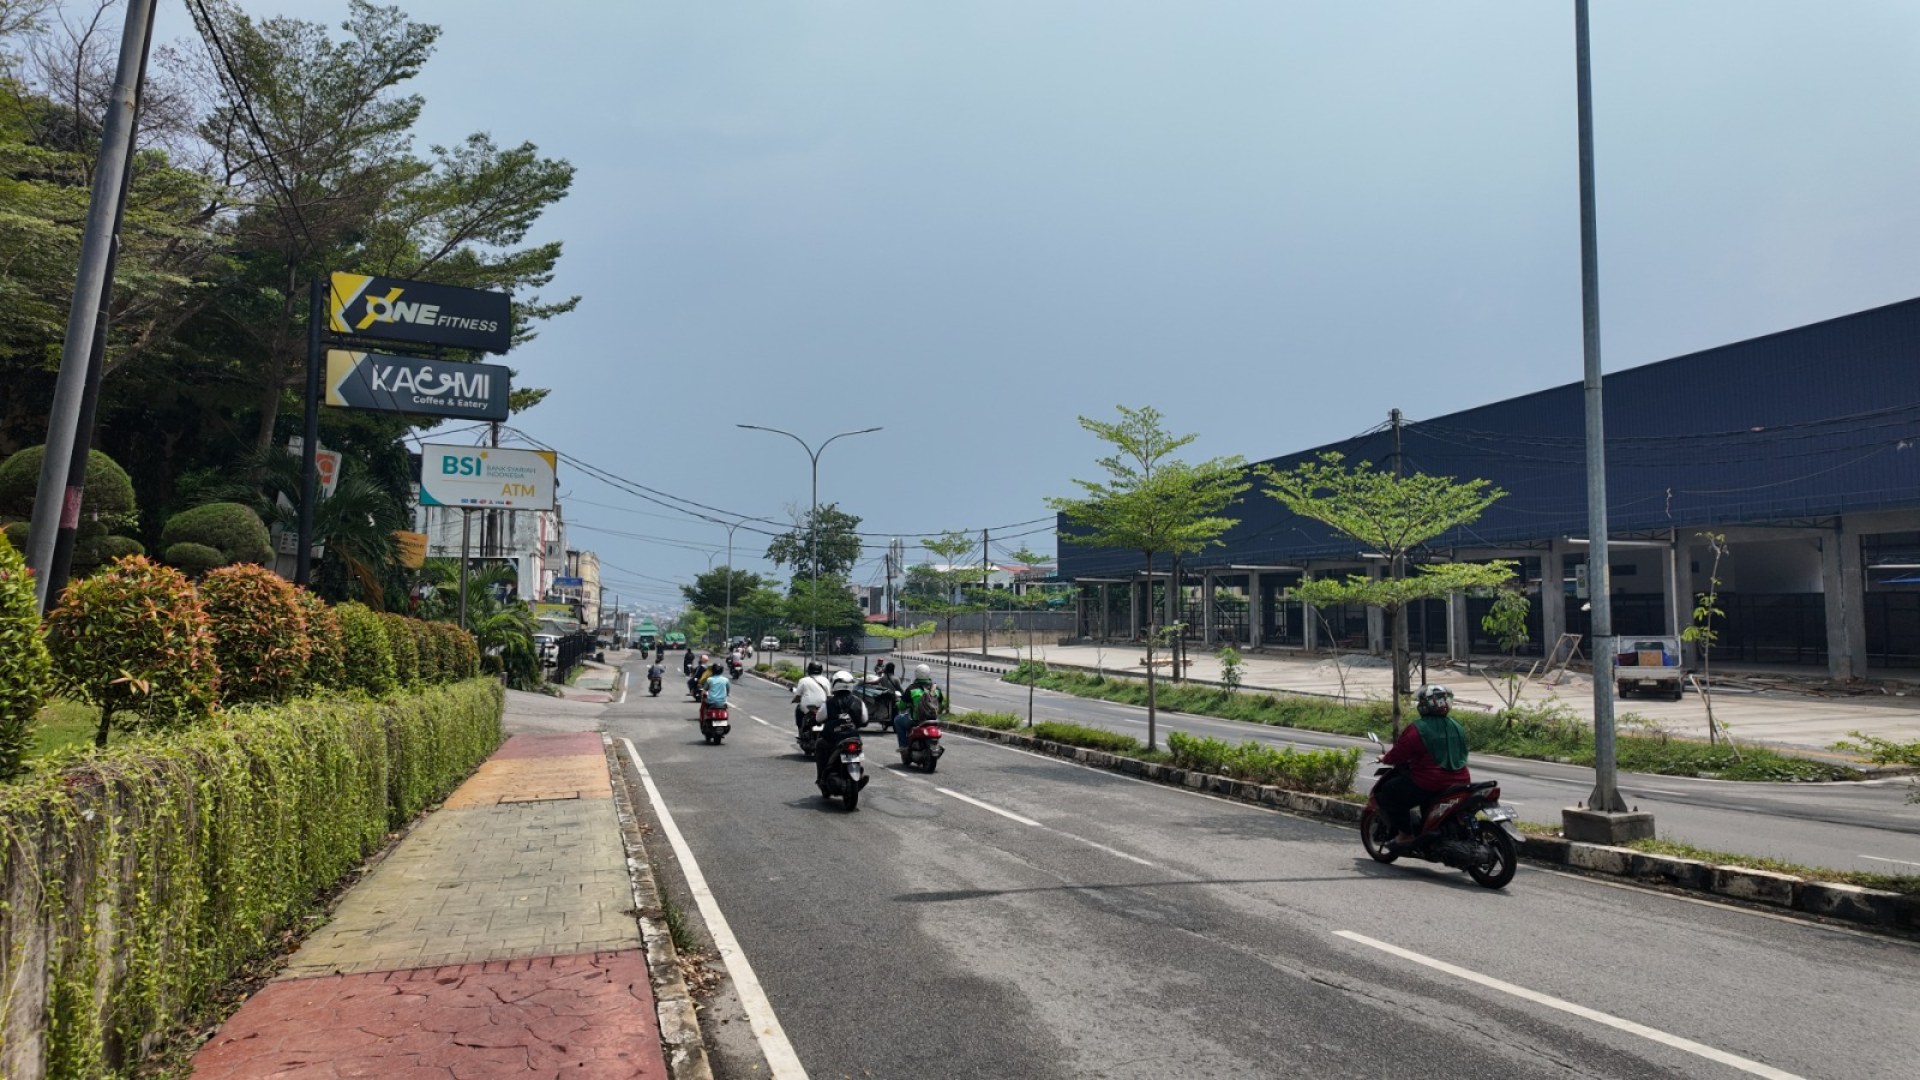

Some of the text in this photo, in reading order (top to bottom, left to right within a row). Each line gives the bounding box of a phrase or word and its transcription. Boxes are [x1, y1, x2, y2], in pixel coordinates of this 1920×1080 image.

[437, 315, 498, 332] FITNESS
[413, 395, 488, 410] Coffee & Eatery
[442, 455, 482, 476] BSI
[486, 465, 505, 473] BANK
[501, 483, 535, 497] ATM
